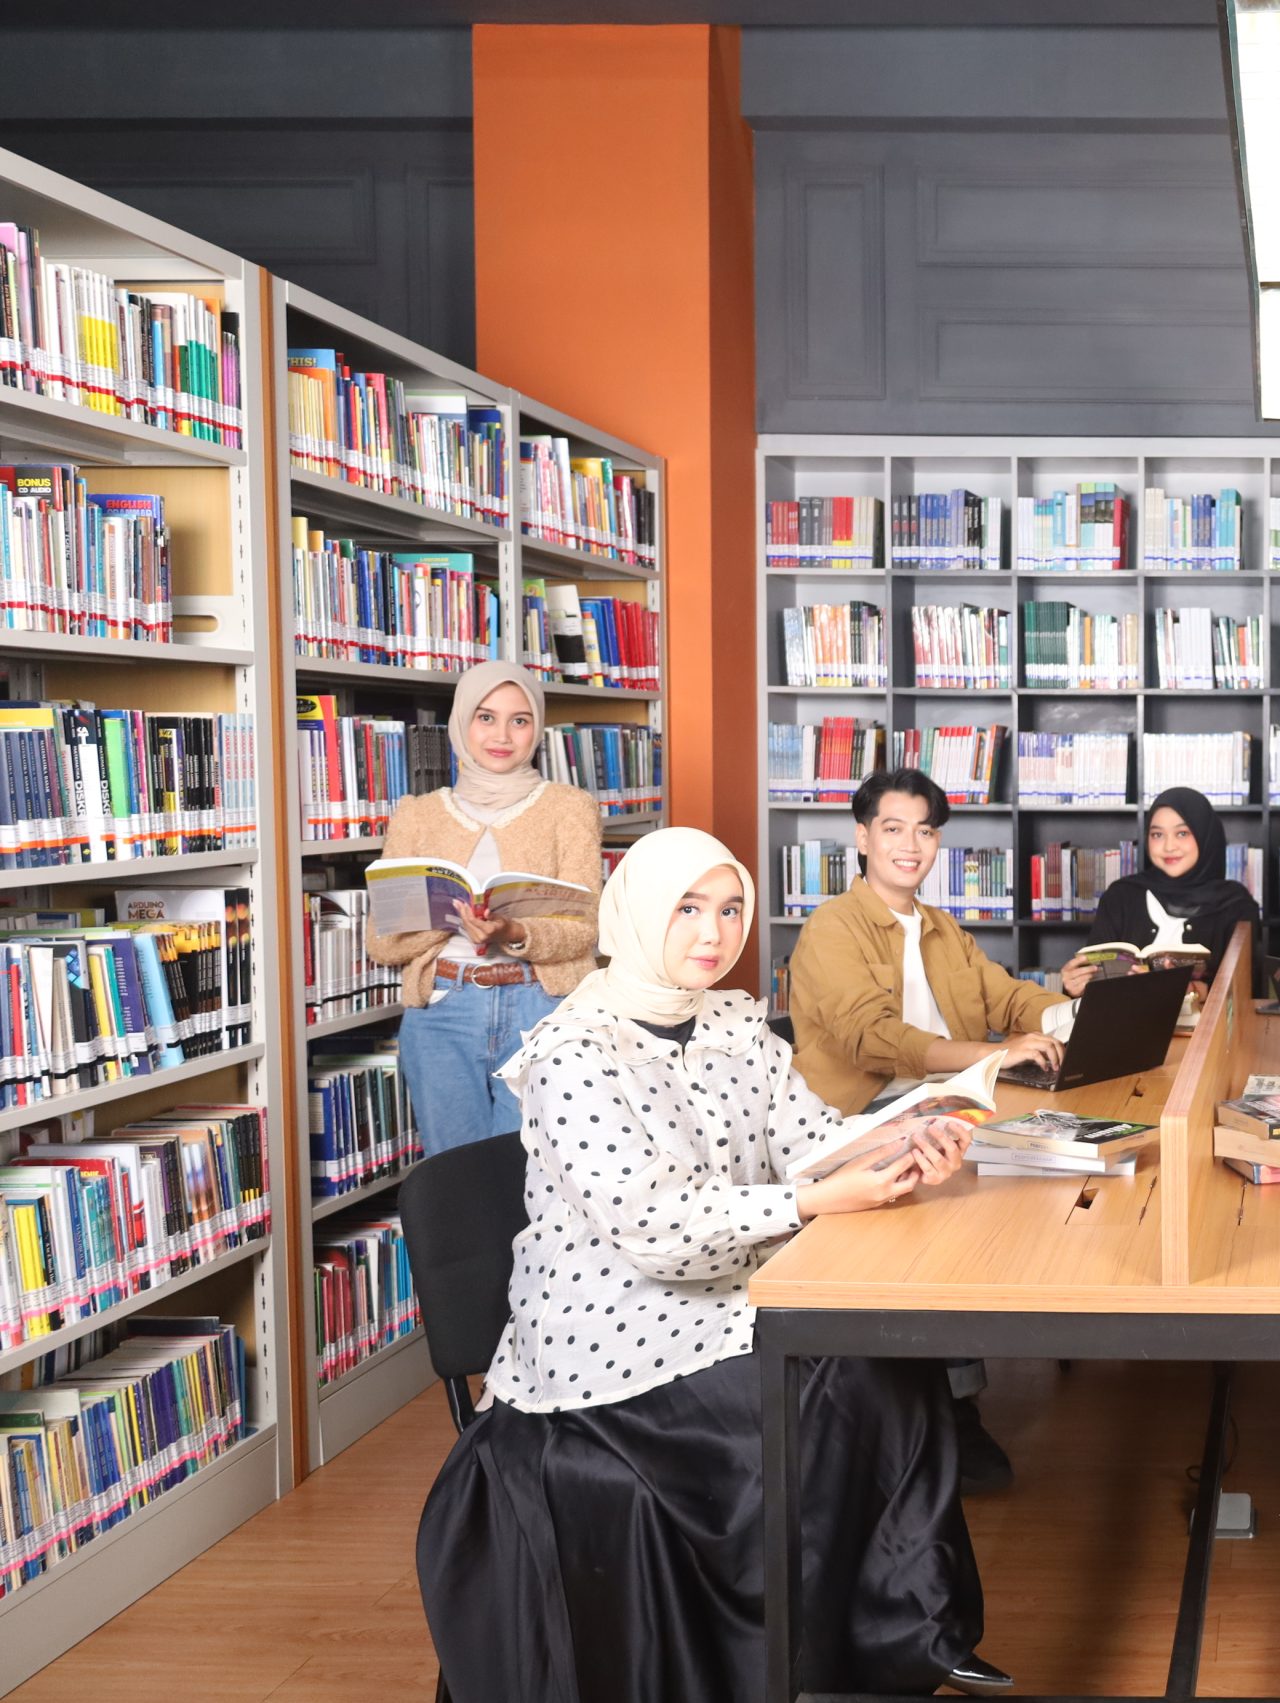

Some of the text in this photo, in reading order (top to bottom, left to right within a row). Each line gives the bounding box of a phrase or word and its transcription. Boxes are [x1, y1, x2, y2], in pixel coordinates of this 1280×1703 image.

[17, 478, 51, 487] BONUS
[107, 500, 152, 509] ENGLISH
[128, 901, 164, 909] ARDUINO
[128, 909, 164, 919] MEGA
